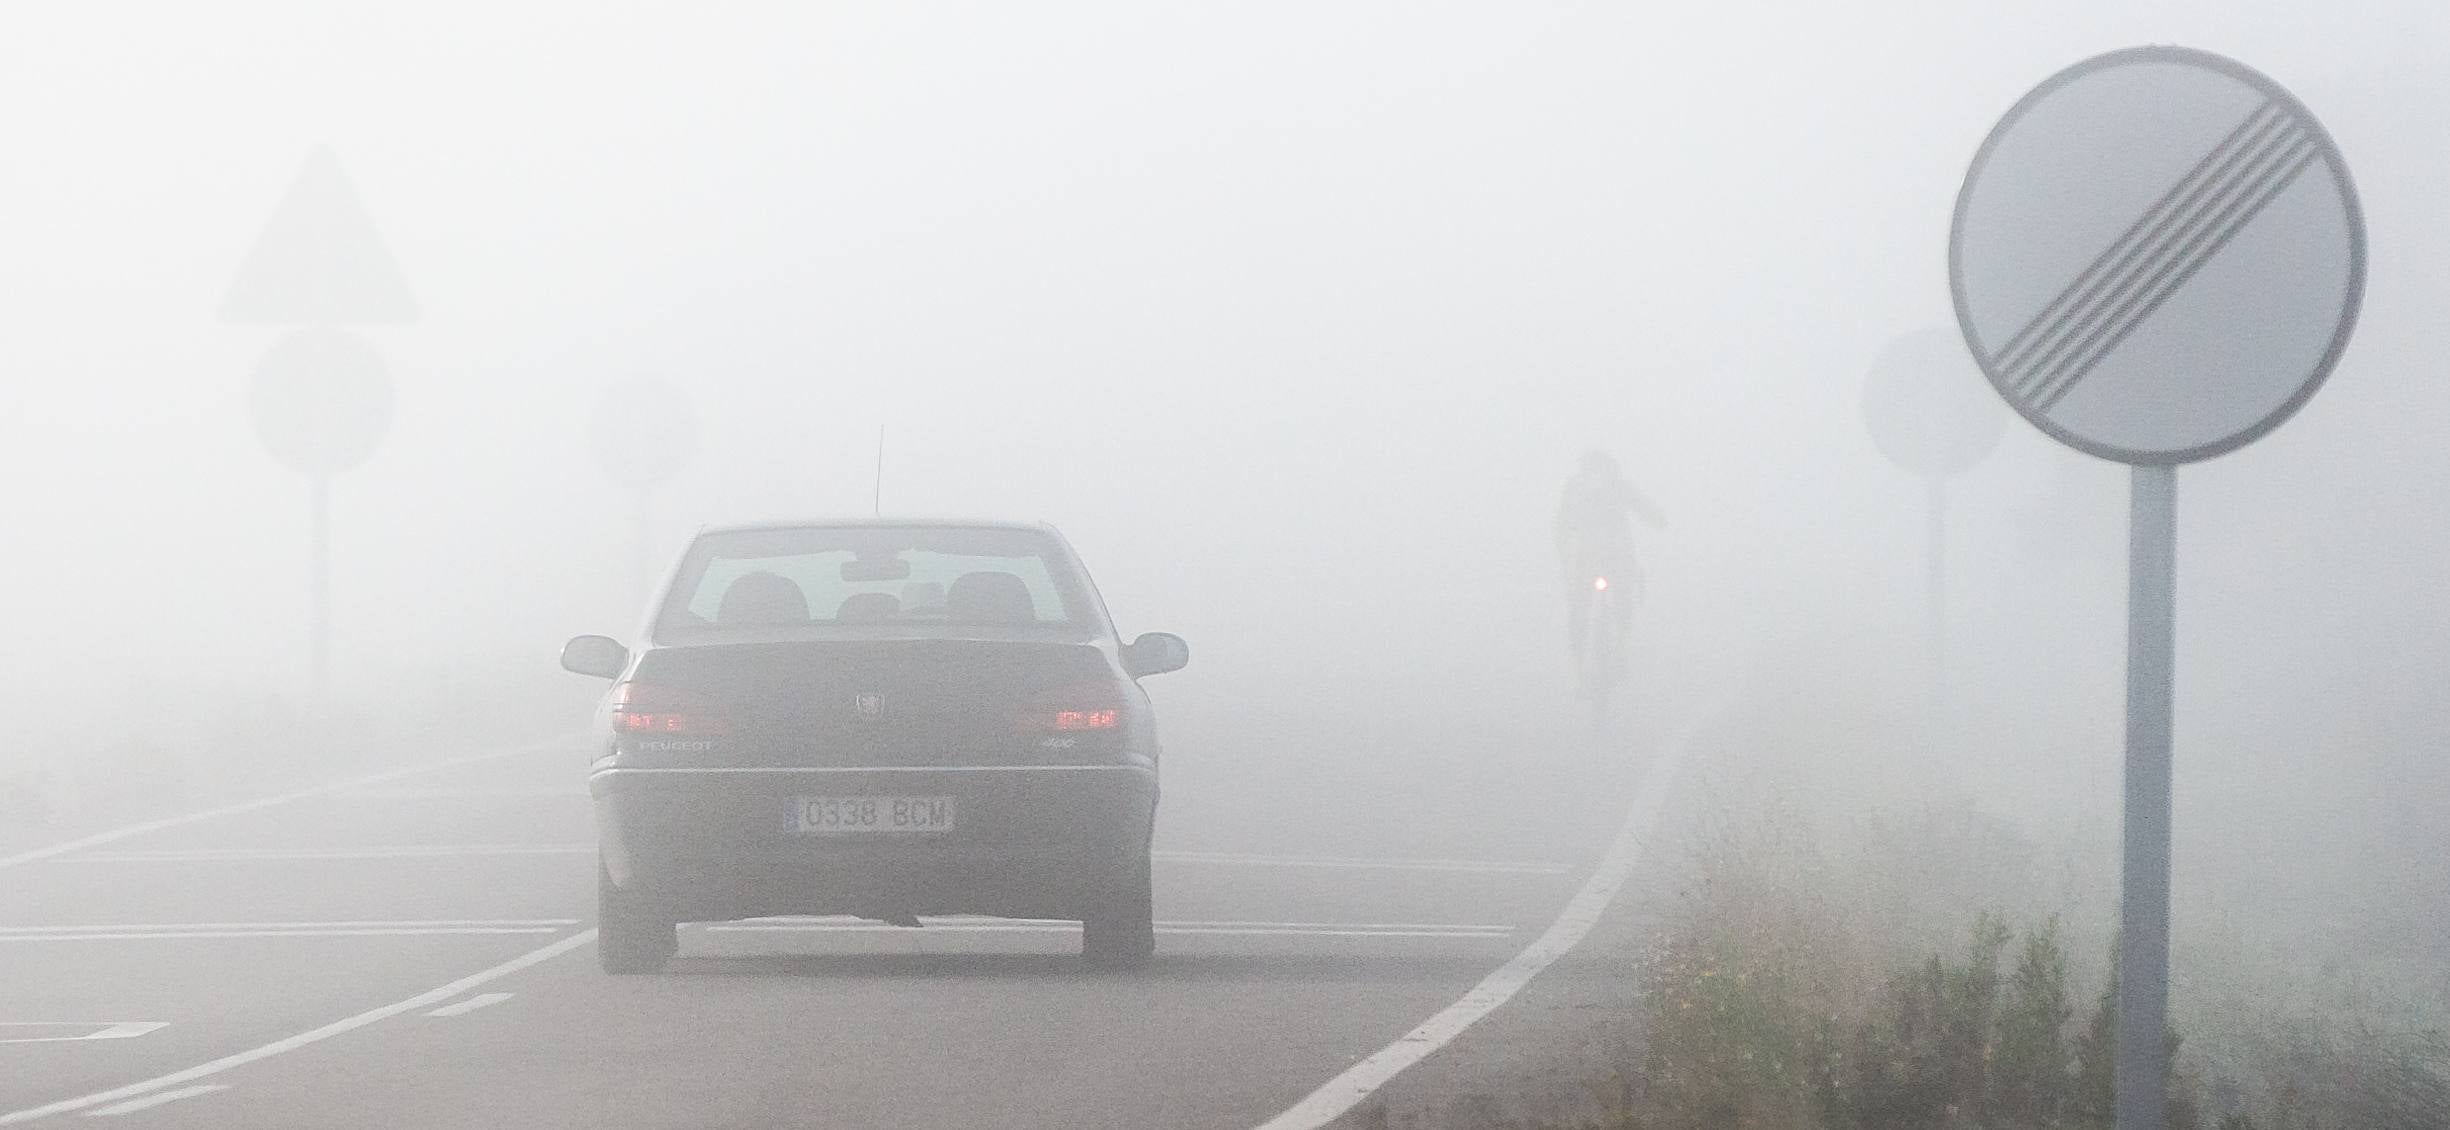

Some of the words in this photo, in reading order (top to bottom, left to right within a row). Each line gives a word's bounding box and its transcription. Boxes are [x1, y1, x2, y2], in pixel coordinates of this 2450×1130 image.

[640, 740, 713, 751] PEUGEOT
[805, 799, 876, 826] 0338
[894, 799, 947, 826] BCM
